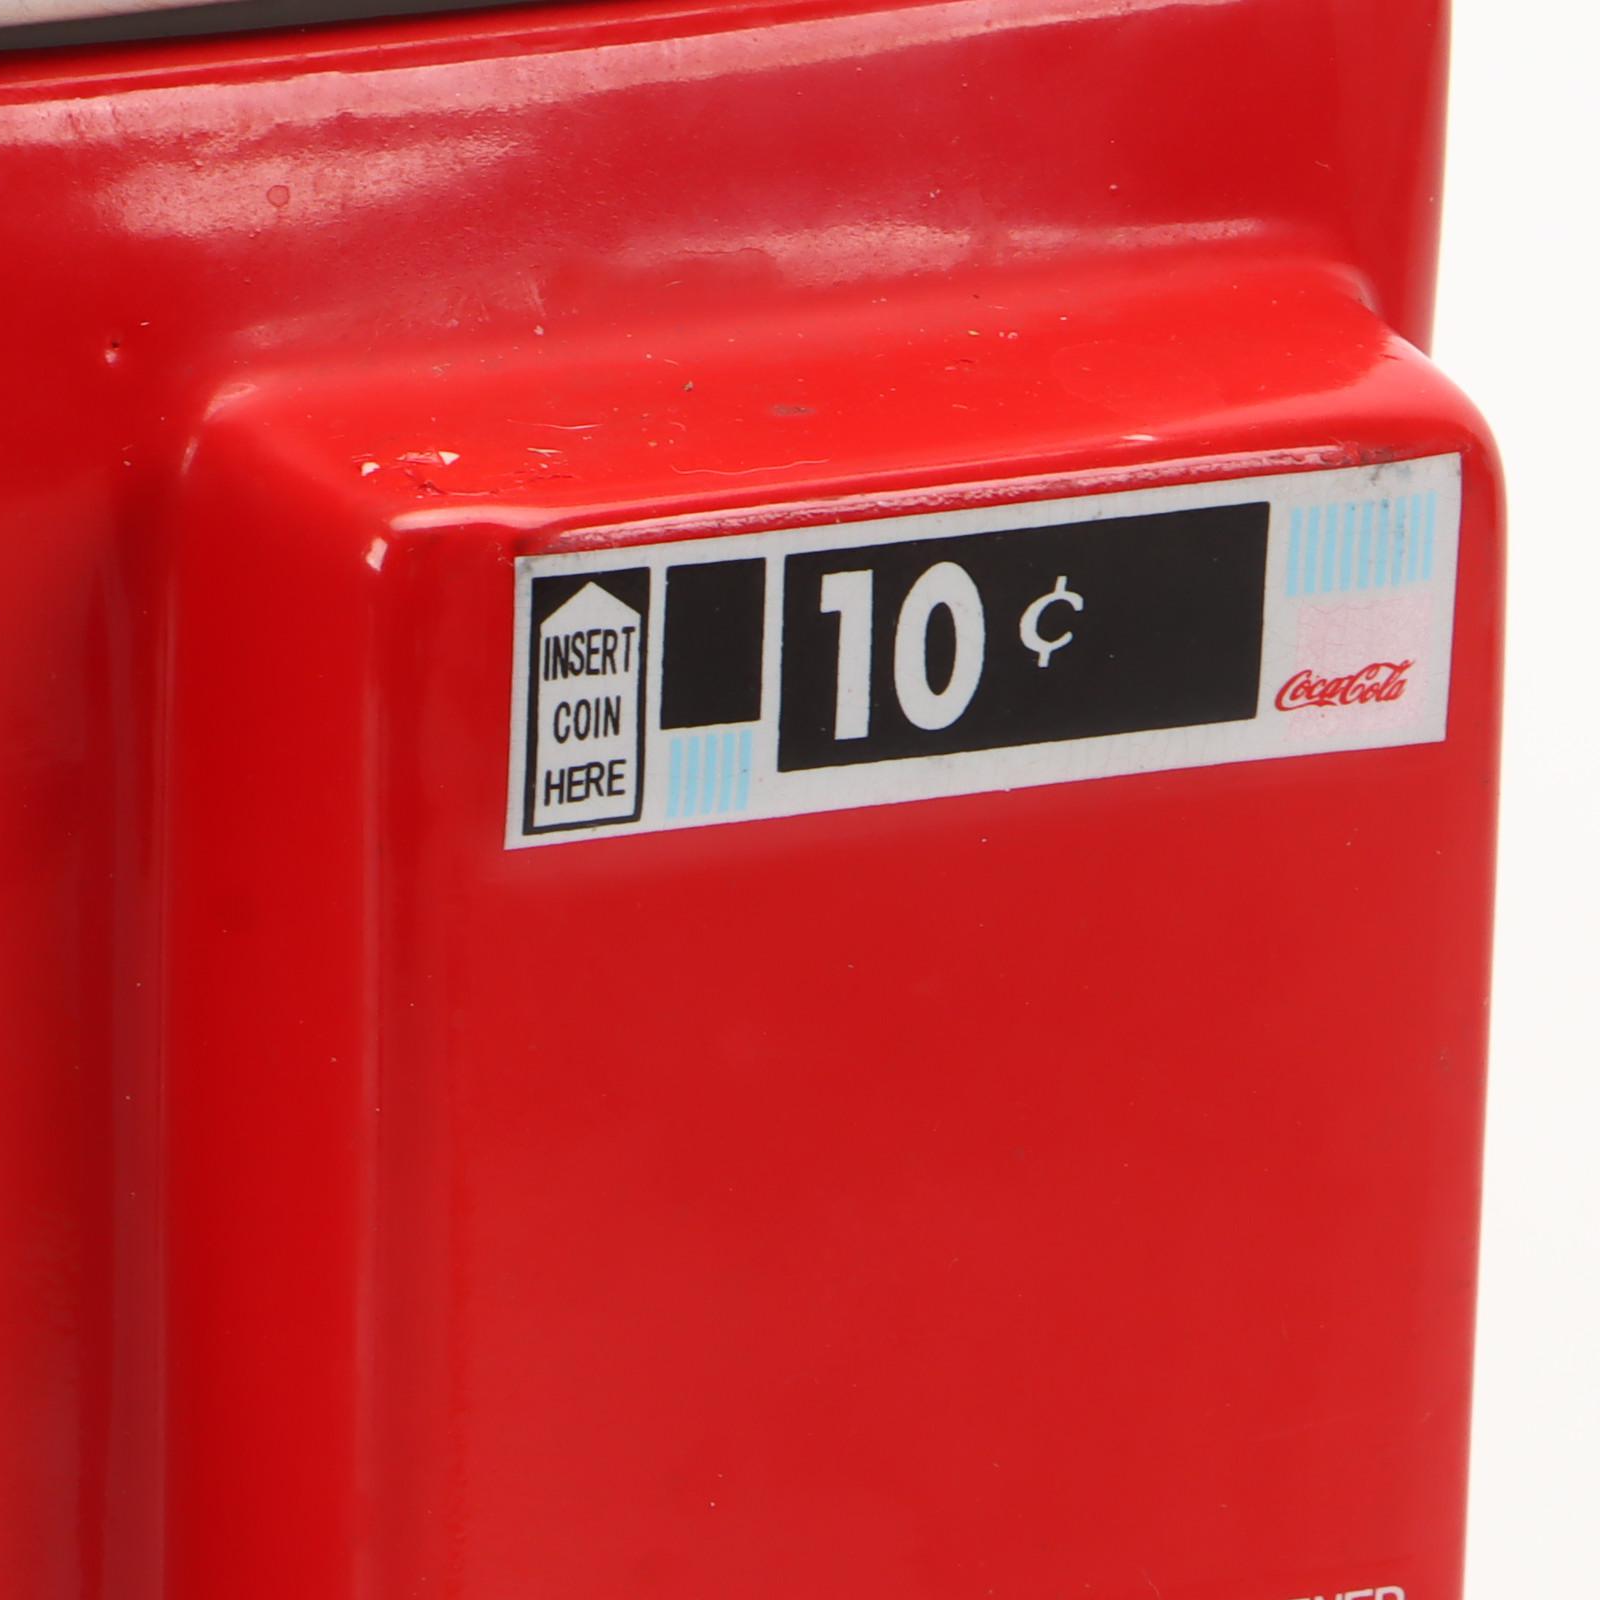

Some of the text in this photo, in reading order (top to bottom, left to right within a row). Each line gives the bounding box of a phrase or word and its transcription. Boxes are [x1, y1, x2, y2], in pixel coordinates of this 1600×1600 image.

[543, 625, 636, 682] INSERT
[820, 561, 986, 740] 10
[553, 695, 621, 744] COIN
[543, 758, 627, 807] HERE
